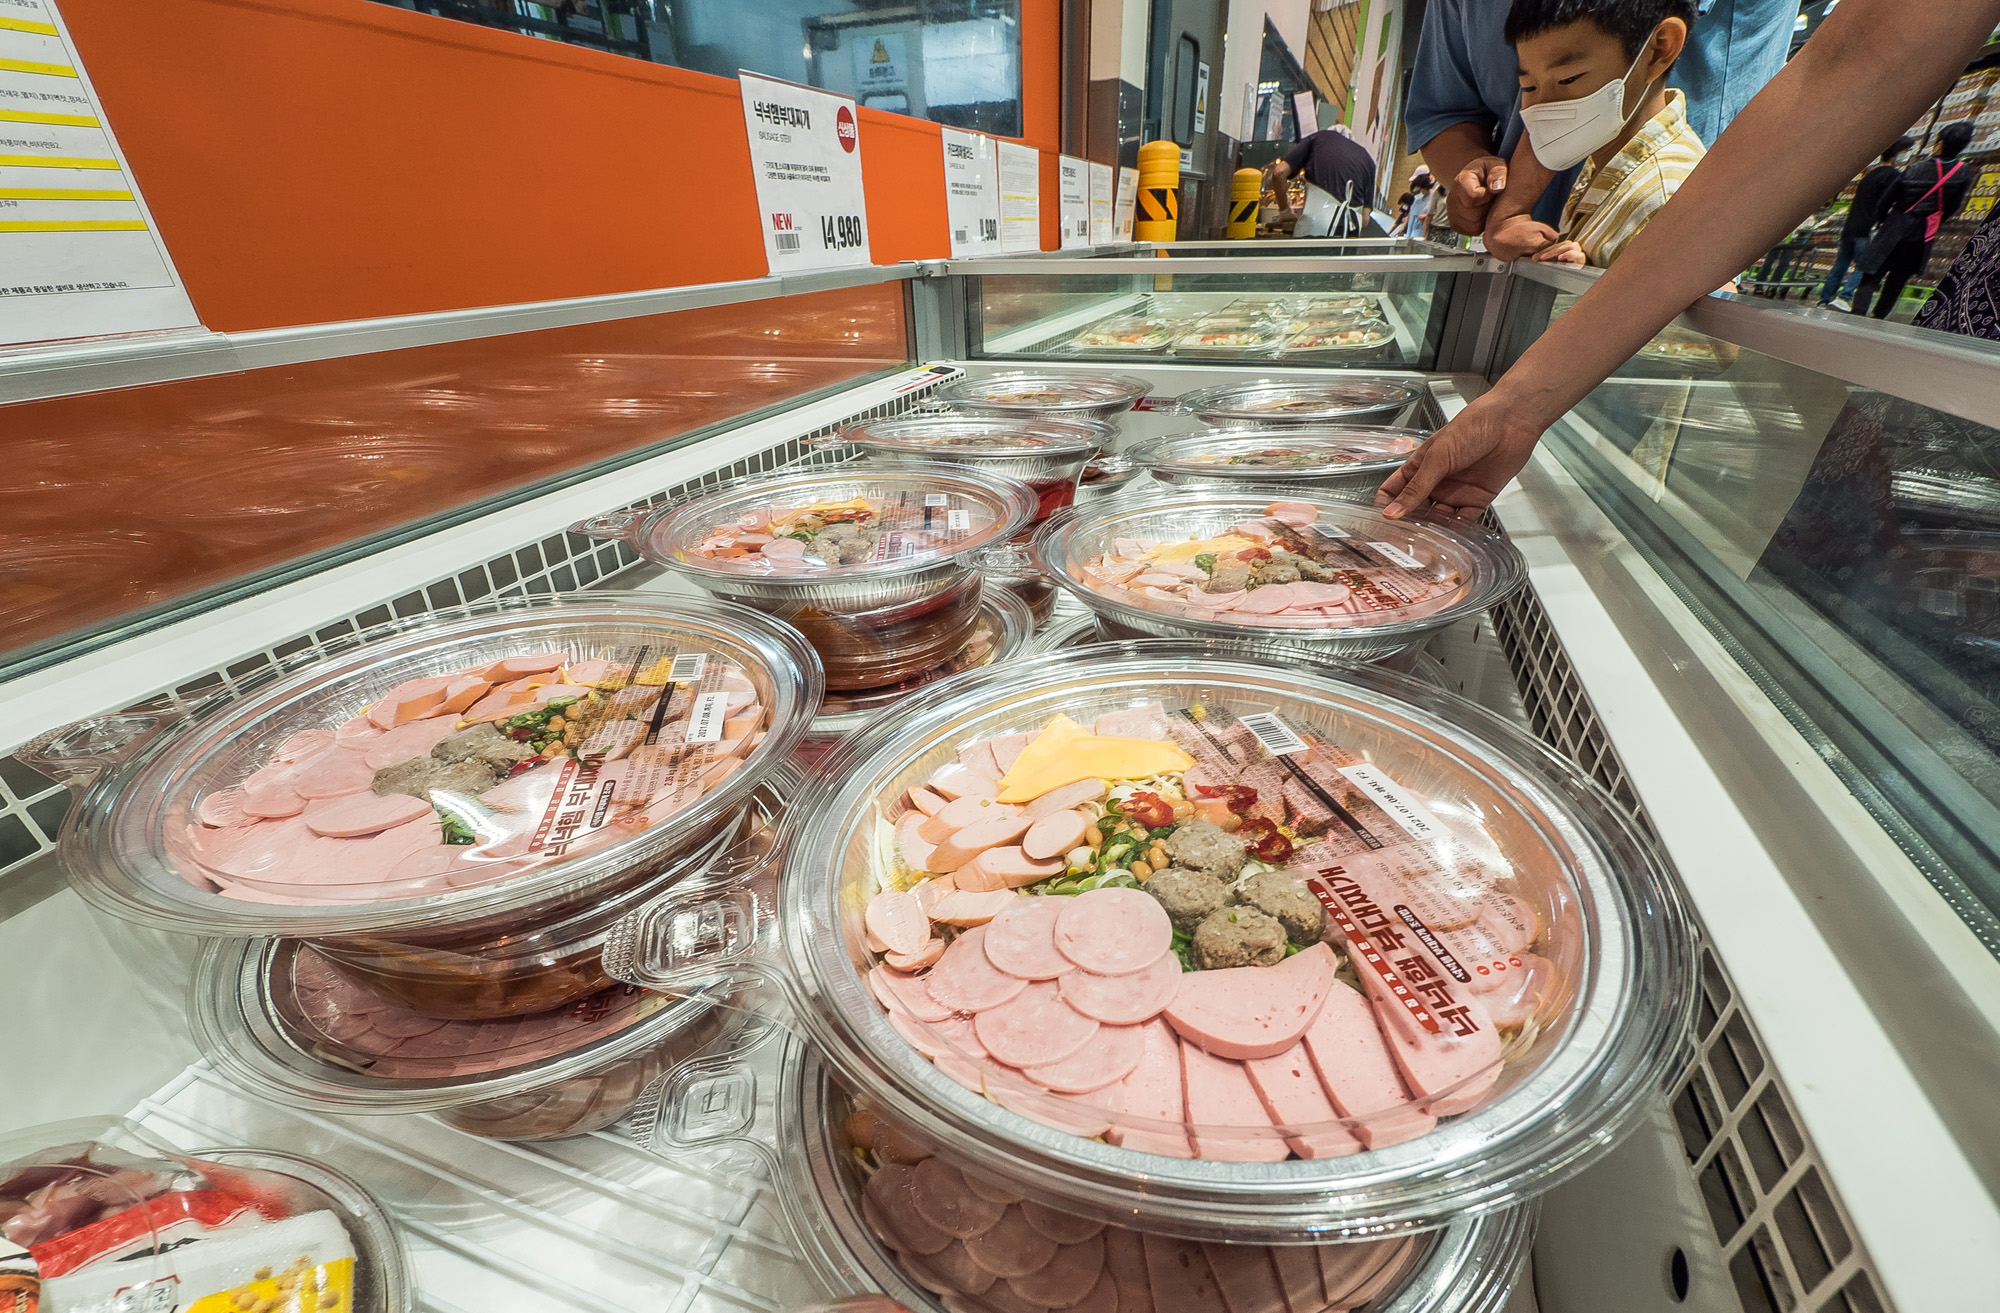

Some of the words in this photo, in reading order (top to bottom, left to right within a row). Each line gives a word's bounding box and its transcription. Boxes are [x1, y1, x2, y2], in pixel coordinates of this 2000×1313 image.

[758, 131, 779, 142] SAUSAGE
[838, 123, 856, 138] 신상품
[772, 213, 793, 231] NEW
[821, 215, 862, 251] 14,980
[544, 811, 584, 855] 넉넉햄
[568, 752, 606, 804] 부대찌개
[1315, 890, 1357, 932] 햄소시지
[1317, 866, 1408, 951] 부대찌개
[1355, 940, 1381, 962] 담은
[1381, 971, 1431, 1022] 푸짐하게
[1394, 956, 1481, 1037] 넉넉햄
